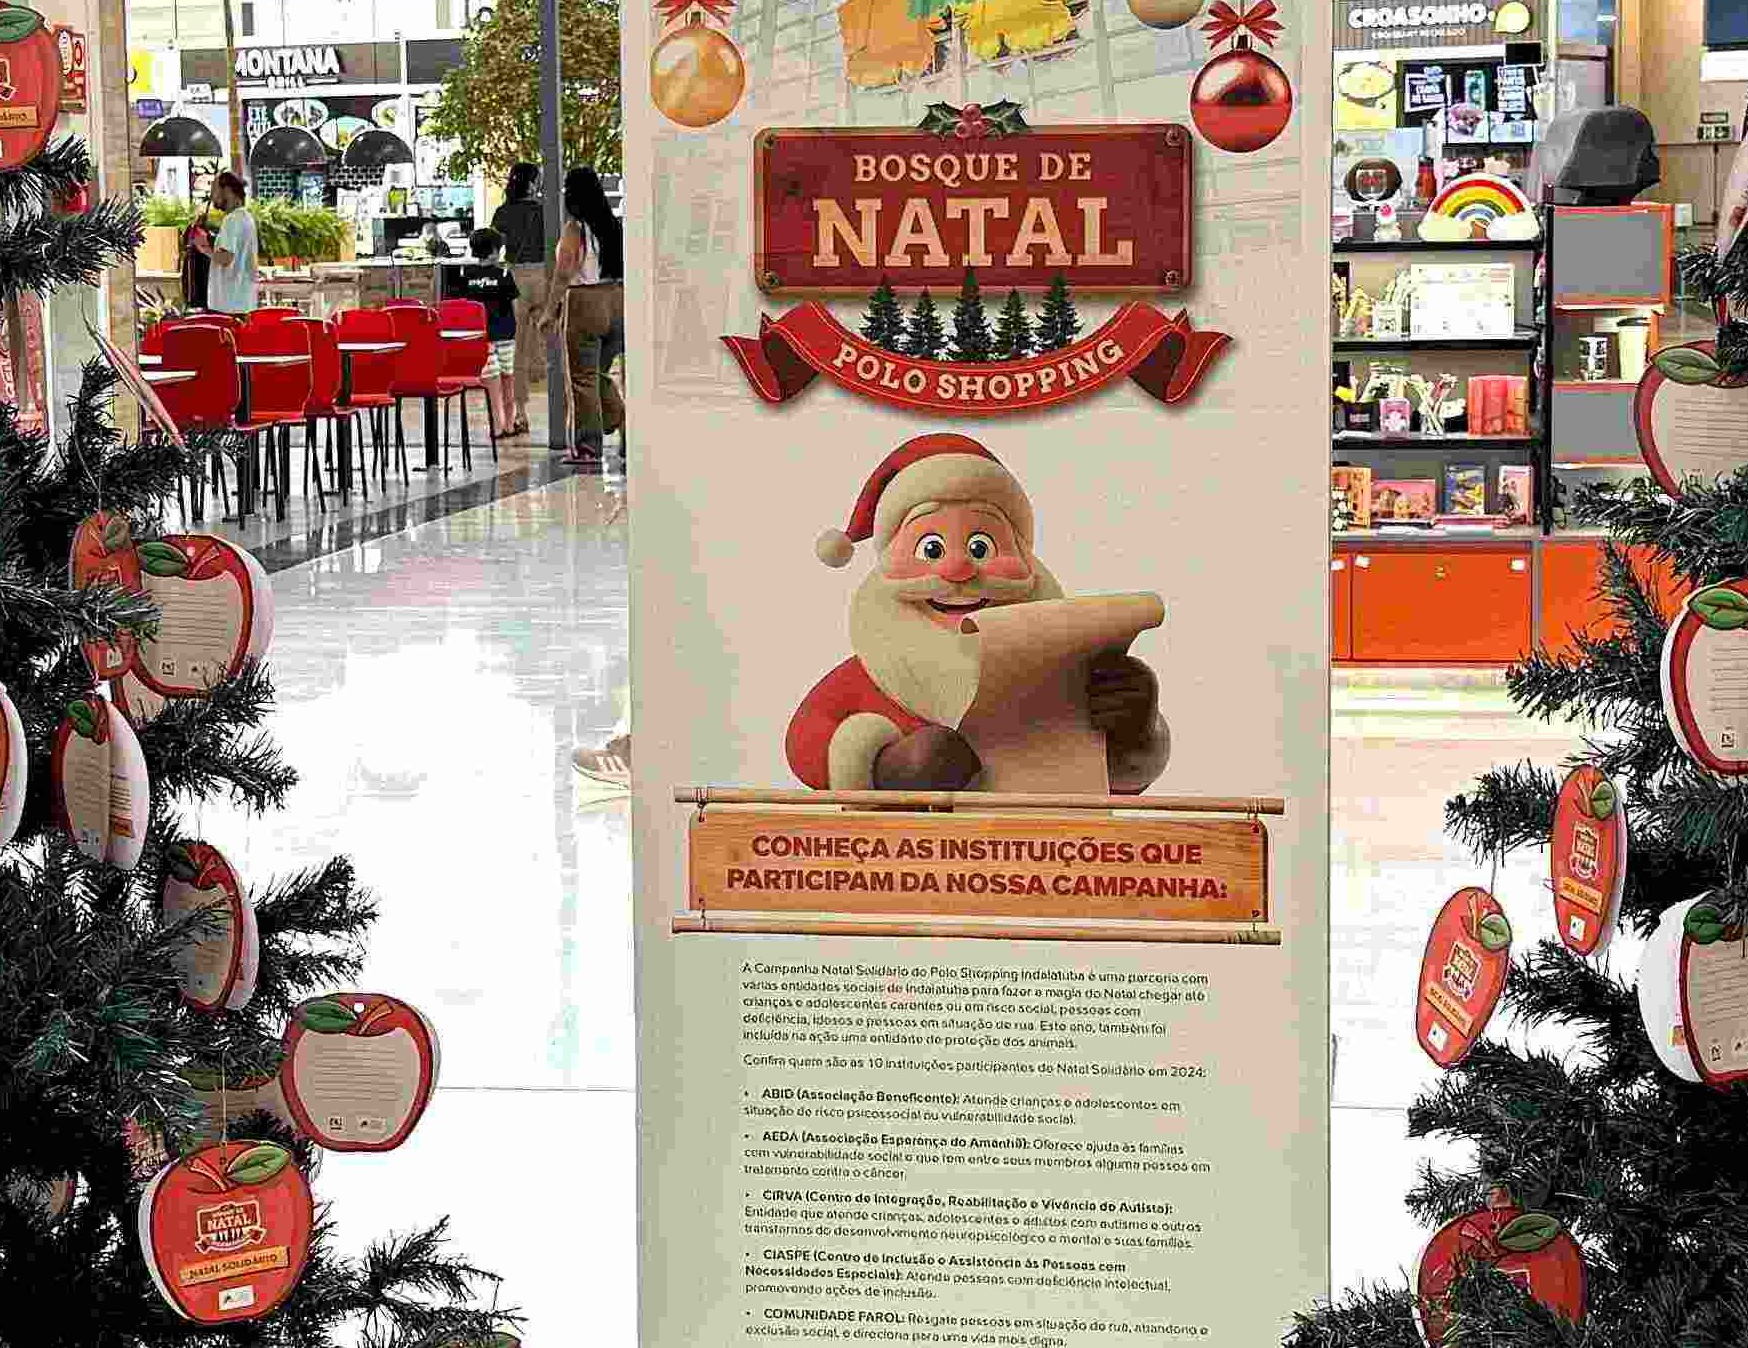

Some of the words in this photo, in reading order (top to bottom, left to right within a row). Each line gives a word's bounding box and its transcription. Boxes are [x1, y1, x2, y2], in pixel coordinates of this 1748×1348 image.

[853, 152, 1020, 189] BOSQUE
[1038, 152, 1093, 182] DE
[812, 196, 1134, 268] NATAL
[832, 344, 928, 394] POLO
[935, 338, 1124, 401] SHOPPING
[751, 834, 891, 863] CONHEÇA
[896, 838, 934, 861] AS
[940, 836, 1135, 867] INSTITUIÇÕES
[1140, 842, 1203, 867] QUE
[726, 867, 894, 893] PARTICIPAM
[900, 870, 940, 894] DA
[946, 871, 1047, 897] NOSSA
[1051, 874, 1229, 900] CAMPANHA:
[762, 1131, 799, 1142] AEDA
[762, 1190, 803, 1201] CIRVA
[206, 1213, 253, 1231] NATAL
[763, 1249, 811, 1261] CIASPE
[764, 1309, 856, 1321] COMUNIDADE
